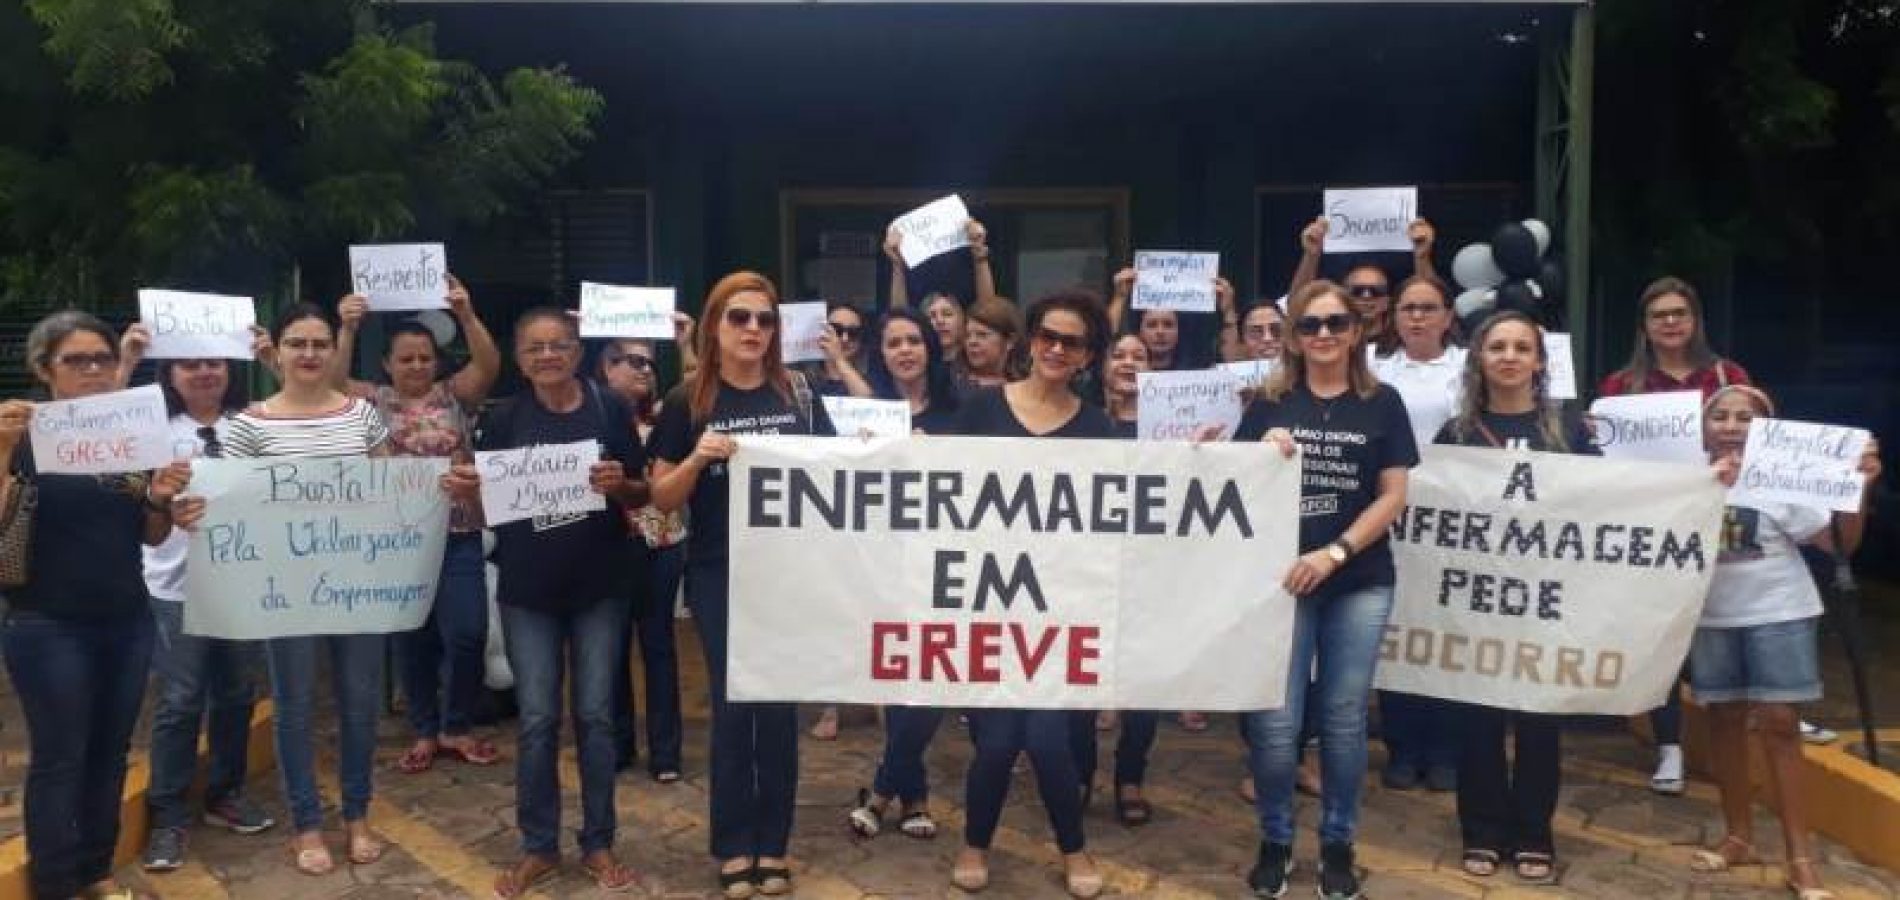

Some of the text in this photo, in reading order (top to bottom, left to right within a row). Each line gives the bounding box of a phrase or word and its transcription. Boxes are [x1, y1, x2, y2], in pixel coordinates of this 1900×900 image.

[353, 248, 438, 292] Respeito
[57, 435, 138, 465] GREVE
[747, 466, 1255, 538] ENFERMAGEM
[1502, 461, 1537, 501] A
[207, 520, 264, 563] Pela
[1390, 505, 1705, 572] NFERMAGEM
[260, 576, 291, 610] da
[932, 549, 1048, 612] EM
[1437, 567, 1564, 621] PEDE
[870, 621, 1100, 685] GREVE
[1378, 625, 1625, 690] SOCORRO
